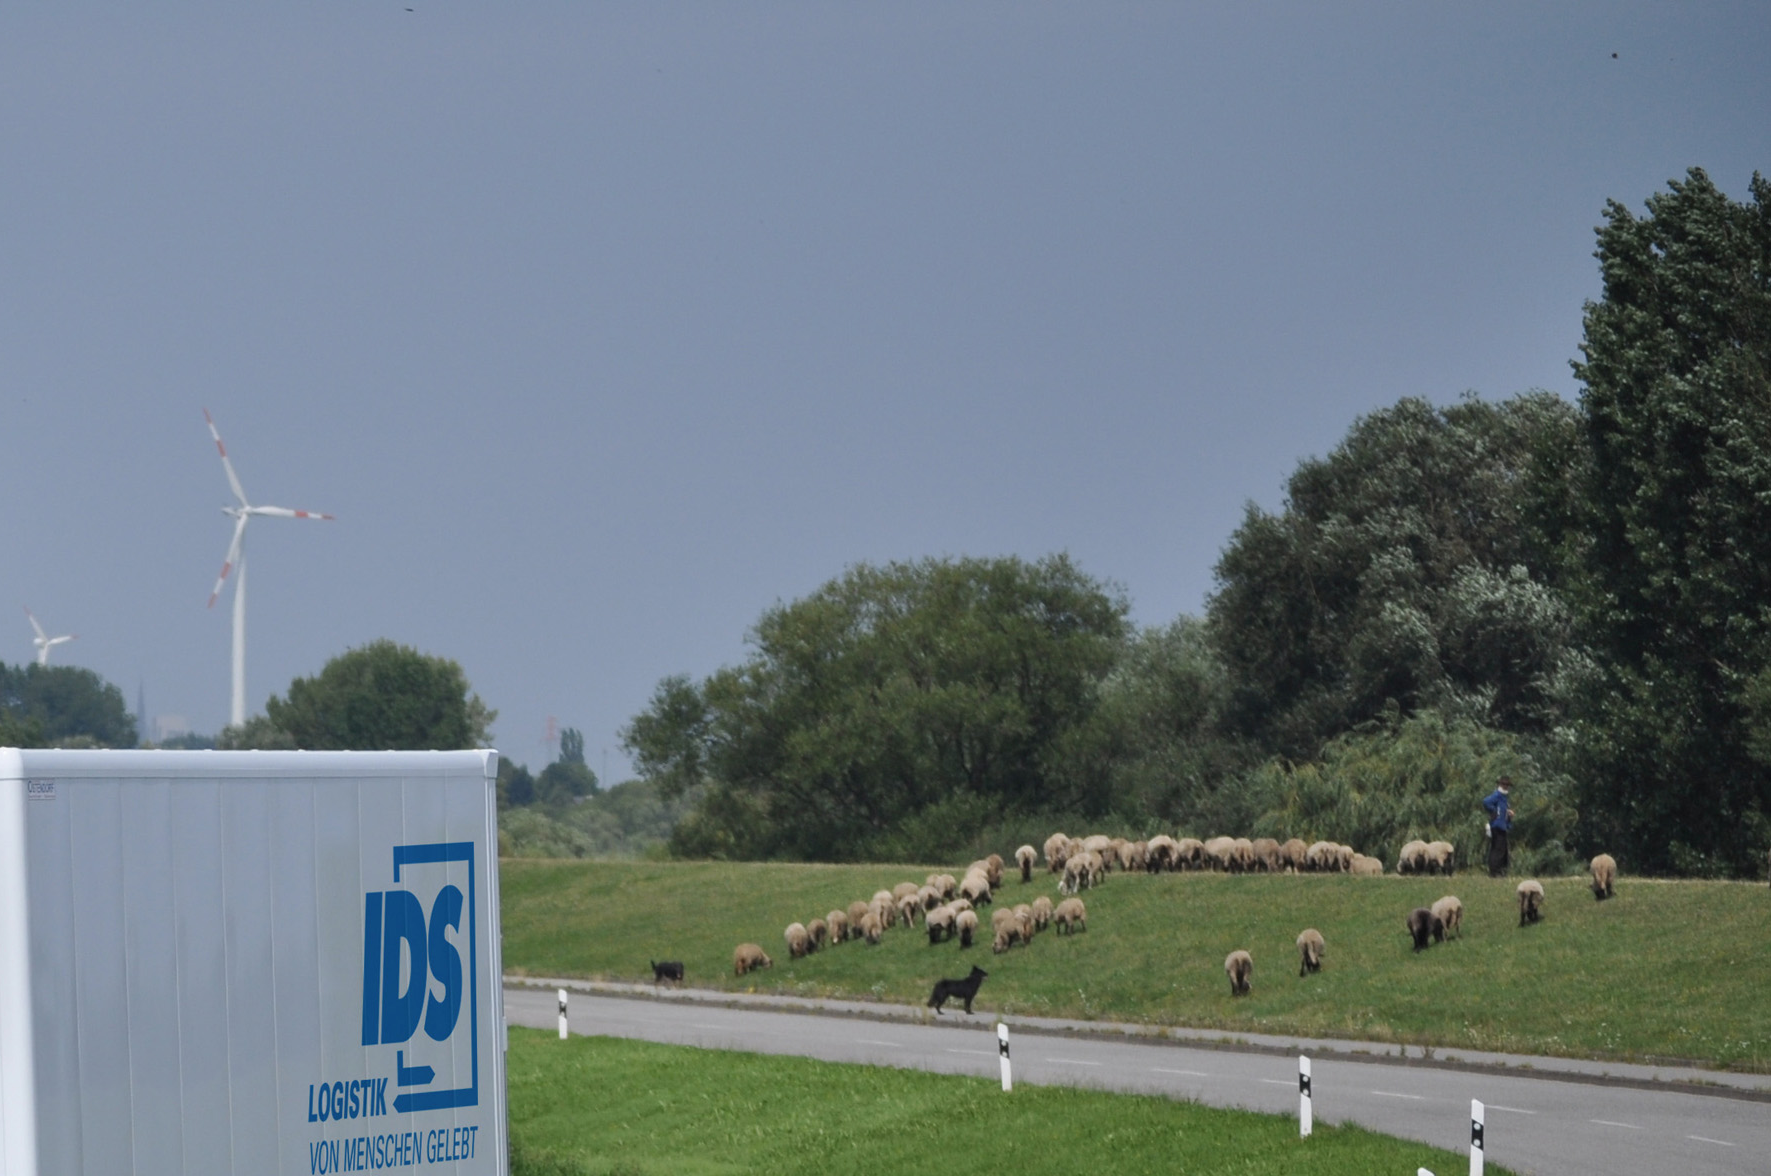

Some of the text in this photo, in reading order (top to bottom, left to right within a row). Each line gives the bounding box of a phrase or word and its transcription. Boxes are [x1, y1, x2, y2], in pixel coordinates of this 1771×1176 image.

[361, 884, 464, 1046] IDS
[308, 1077, 388, 1123] LOGISTIK
[309, 1125, 479, 1175] VON MENSCHEN GELEBT
